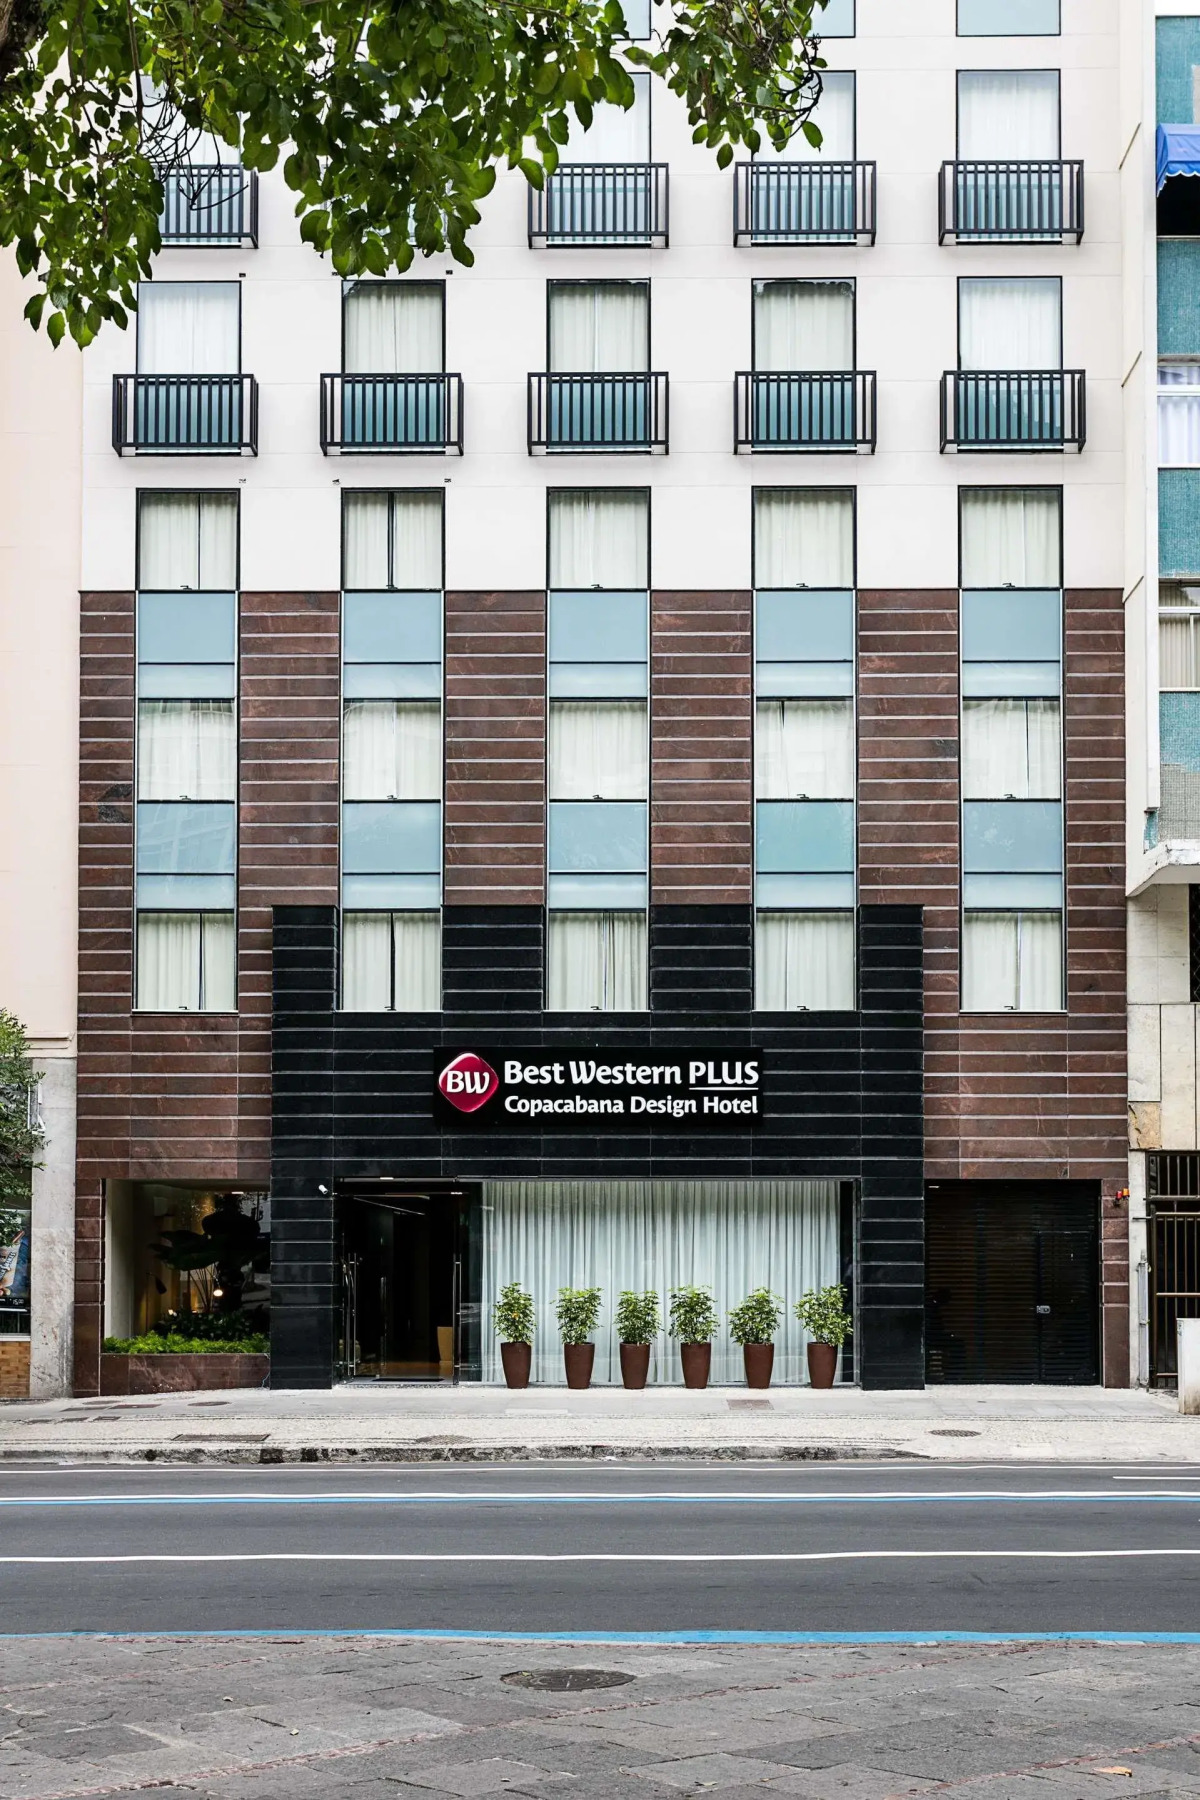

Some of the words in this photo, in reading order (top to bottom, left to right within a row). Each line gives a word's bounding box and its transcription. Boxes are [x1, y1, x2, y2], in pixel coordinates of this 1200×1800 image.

[446, 1070, 490, 1094] BW
[504, 1061, 565, 1084] Best
[569, 1061, 682, 1085] Western
[689, 1061, 759, 1085] PLUS
[504, 1095, 624, 1117] Copacabana
[630, 1095, 697, 1117] Design
[703, 1096, 758, 1114] Hotel
